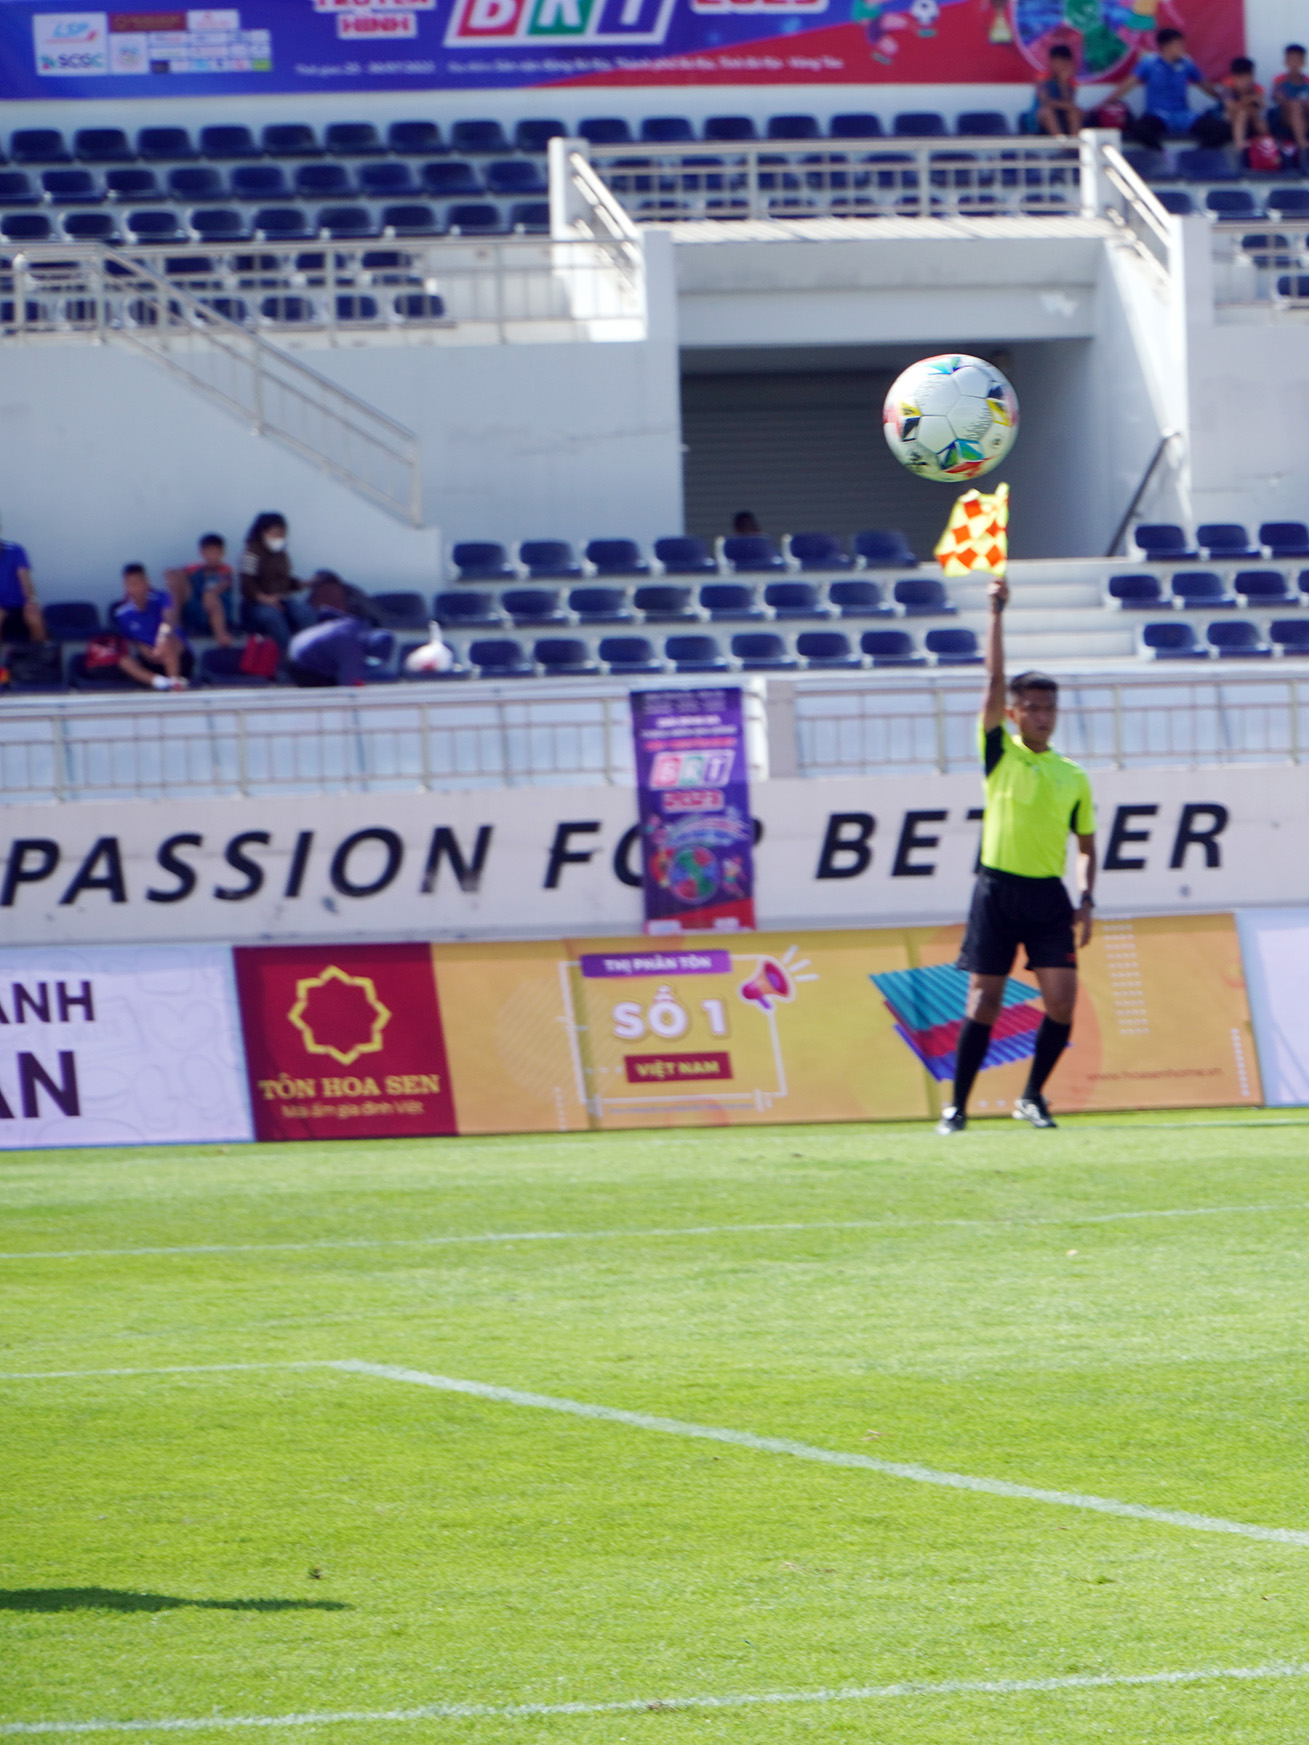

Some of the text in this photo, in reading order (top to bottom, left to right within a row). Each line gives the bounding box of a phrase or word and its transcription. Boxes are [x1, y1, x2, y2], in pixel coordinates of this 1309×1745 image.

[0, 826, 493, 904] PASSION
[815, 803, 1230, 880] BEER
[0, 980, 95, 1024] NH
[702, 998, 727, 1035] 1
[0, 1050, 80, 1119] N
[322, 1076, 381, 1098] HOA
[384, 1074, 440, 1096] SEN
